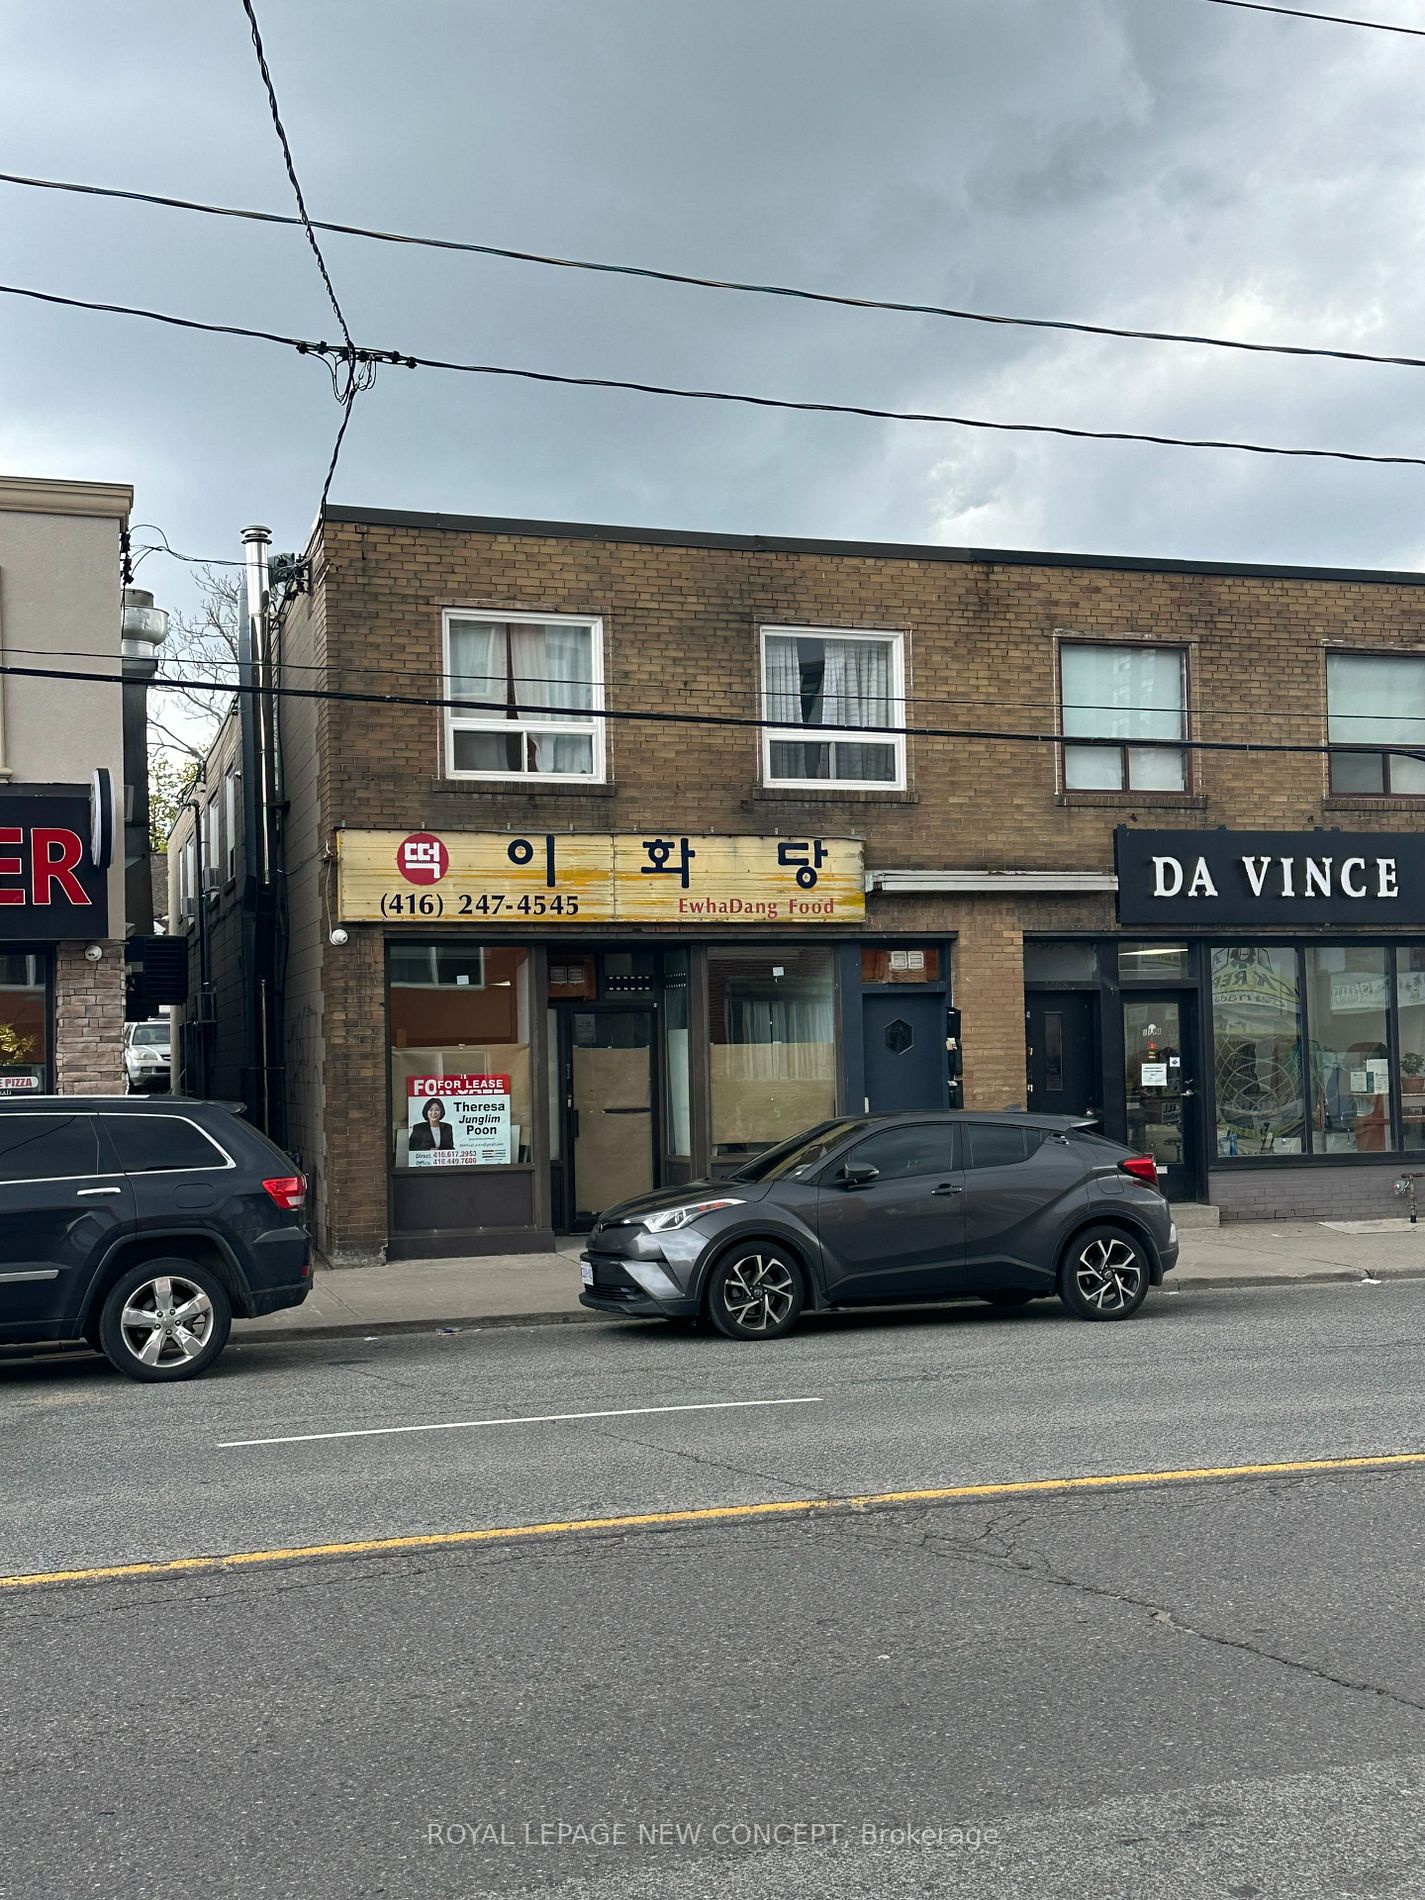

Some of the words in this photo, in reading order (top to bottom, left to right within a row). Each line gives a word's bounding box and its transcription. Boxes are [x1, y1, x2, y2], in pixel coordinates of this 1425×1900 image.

[404, 841, 441, 880] 떡
[1151, 856, 1219, 898] DA
[1241, 856, 1399, 898] VINCE
[380, 892, 444, 918] (416)
[458, 893, 579, 915] 247-4545
[678, 897, 778, 918] EwhaDang
[788, 897, 835, 914] Food
[5, 1078, 32, 1088] PIZZA
[438, 1079, 461, 1089] FOR
[466, 1079, 504, 1089] LEASE
[453, 1101, 506, 1112] Theresa
[458, 1114, 501, 1126] Junglim
[466, 1125, 497, 1136] Poon
